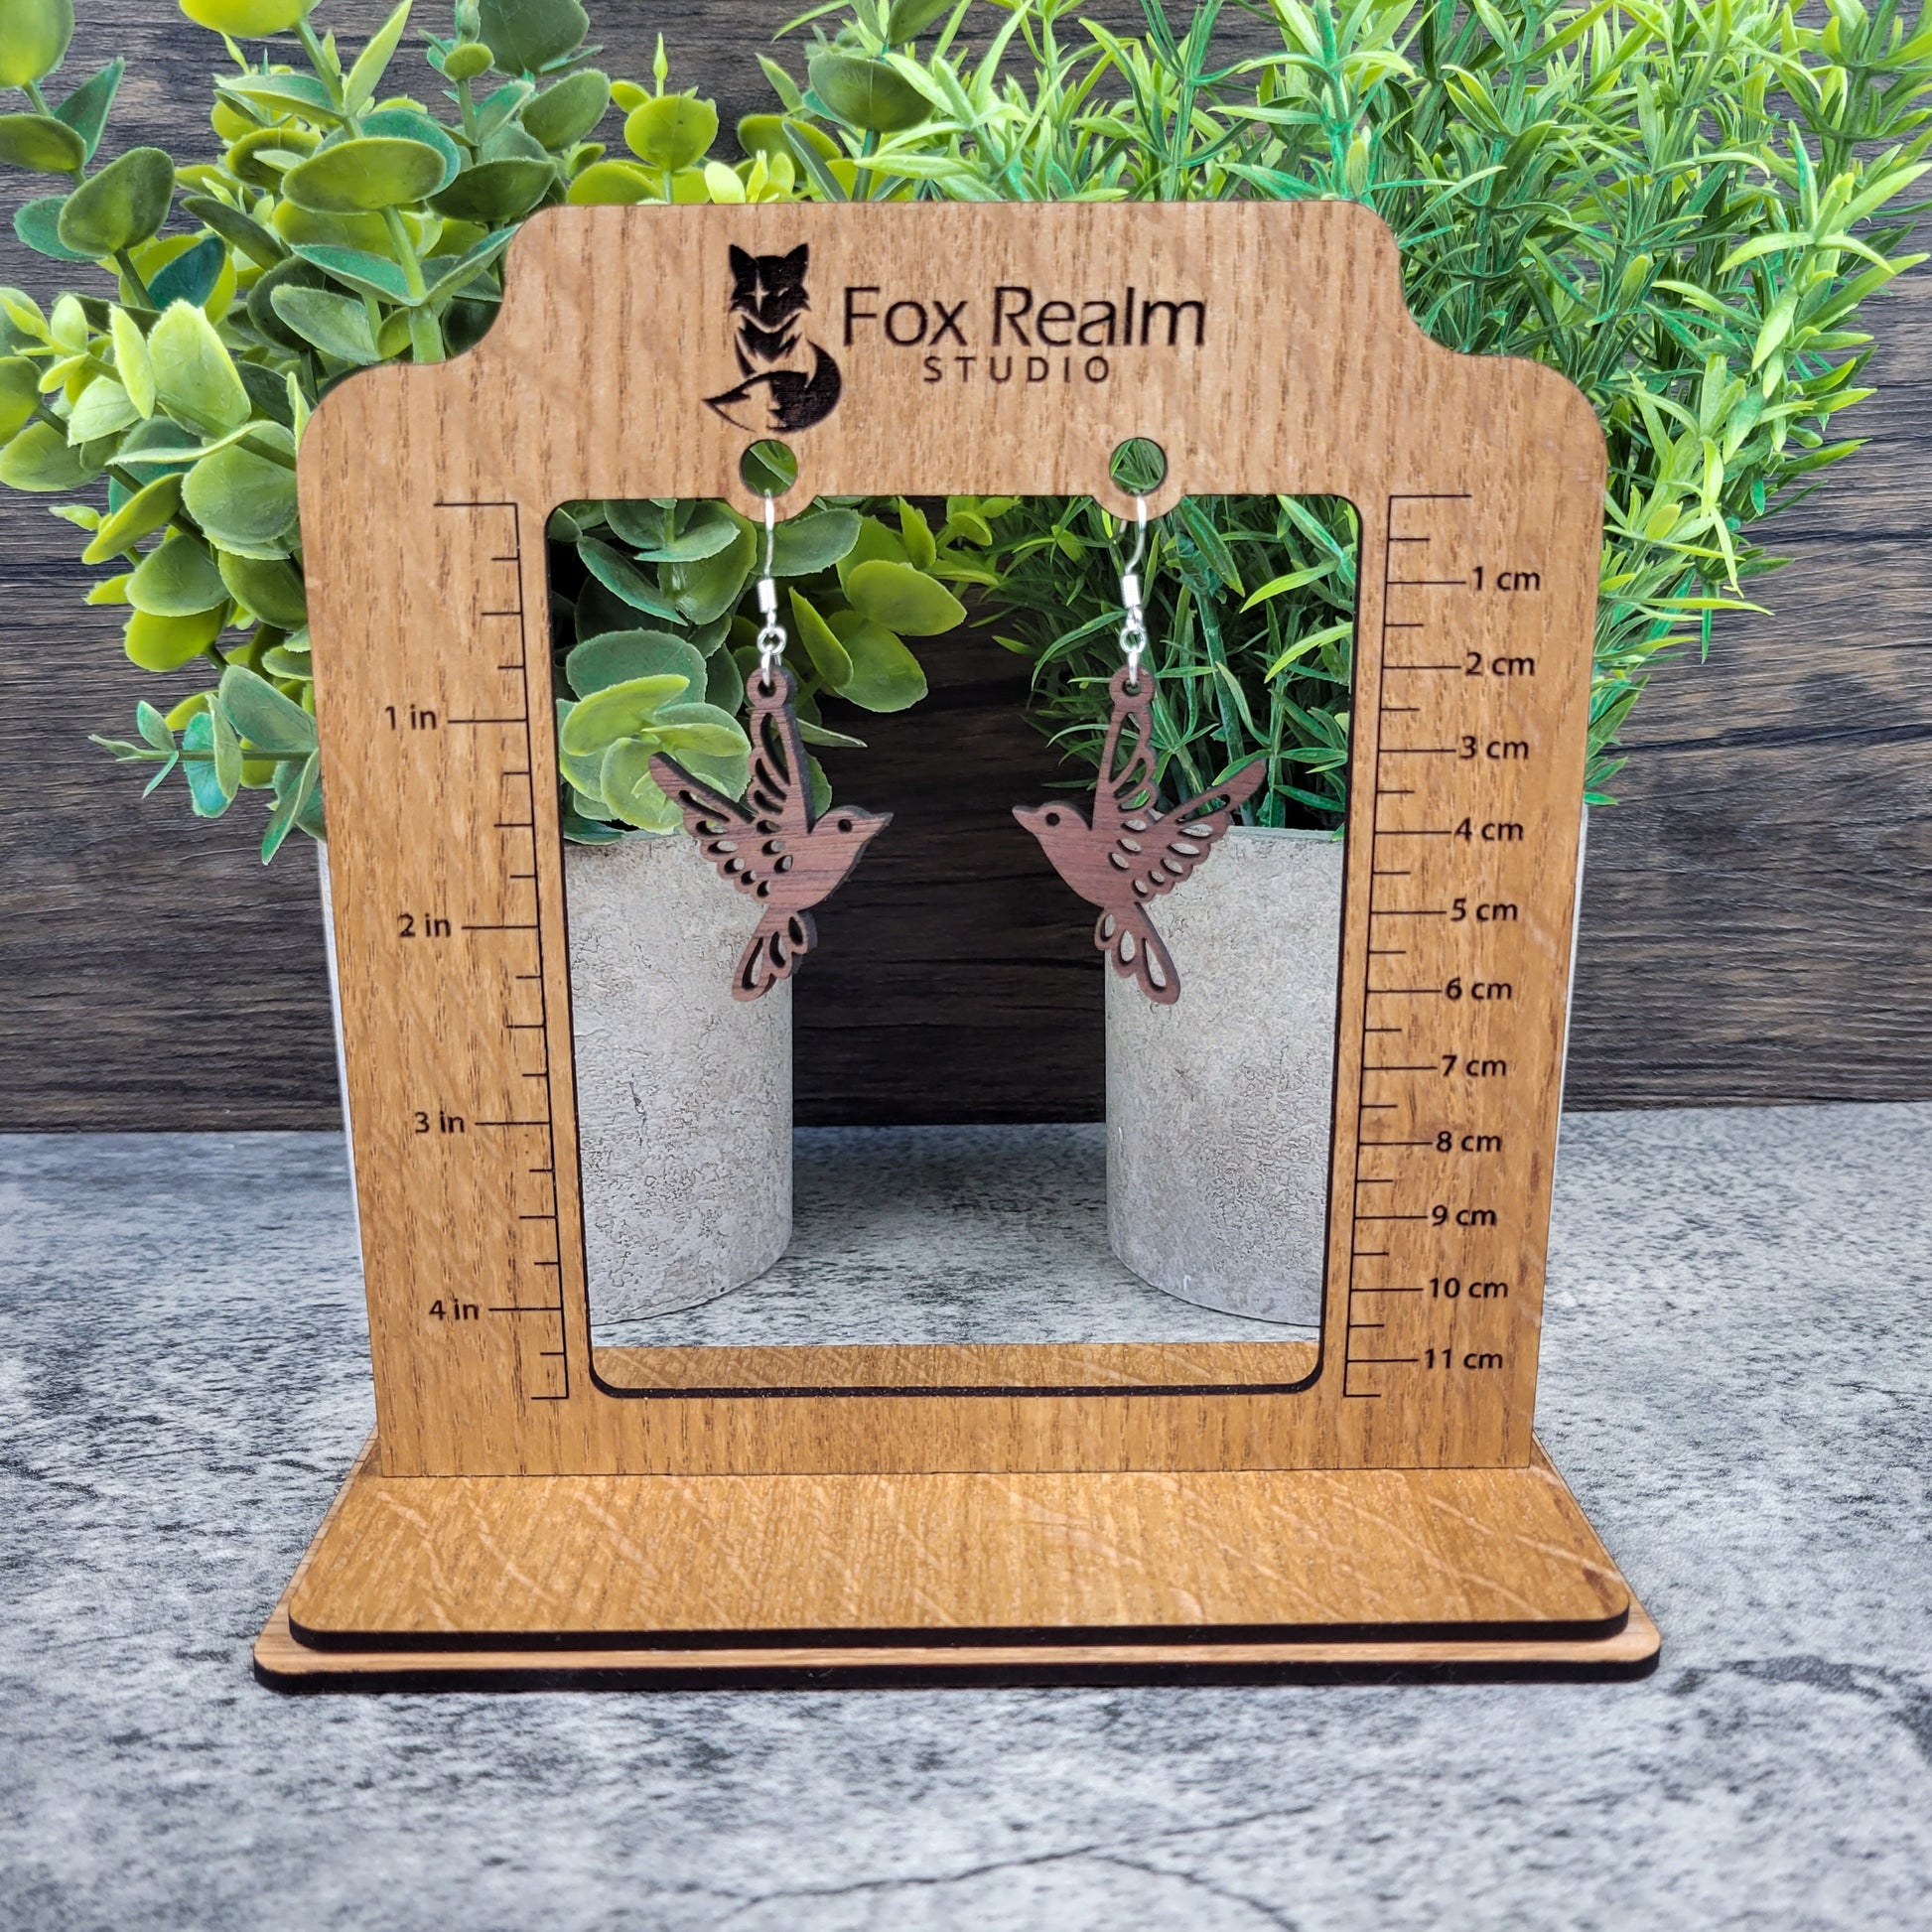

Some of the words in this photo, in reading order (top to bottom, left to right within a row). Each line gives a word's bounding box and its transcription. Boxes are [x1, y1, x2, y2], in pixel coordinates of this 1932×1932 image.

[843, 286, 968, 346] Fox
[993, 286, 1206, 346] Realm
[922, 355, 1111, 383] STUDIO
[1472, 566, 1484, 591] 1
[1496, 572, 1541, 592] cm
[1466, 652, 1482, 677] 2
[1491, 658, 1535, 677] cm
[385, 706, 395, 731] 1
[409, 705, 437, 730] in
[1460, 736, 1476, 760] 3
[1486, 742, 1529, 760] cm
[1454, 818, 1472, 841] 4
[1481, 822, 1524, 841] cm
[1450, 898, 1467, 921] 5
[1476, 902, 1518, 921] cm
[398, 914, 415, 937] 2
[426, 913, 451, 937] in
[1446, 977, 1461, 1000] 6
[1470, 982, 1512, 1000] cm
[1442, 1054, 1457, 1077] 7
[1465, 1058, 1506, 1077] cm
[415, 1112, 430, 1134] 3
[440, 1111, 465, 1133] in
[1436, 1131, 1452, 1153] 8
[1461, 1135, 1501, 1153] cm
[1431, 1204, 1448, 1226] 9
[1455, 1208, 1496, 1226] cm
[1429, 1277, 1460, 1299] 10
[1468, 1281, 1508, 1299] cm
[429, 1300, 446, 1320] 4
[454, 1298, 480, 1320] in
[1424, 1348, 1452, 1369] 11
[1463, 1352, 1503, 1370] cm
